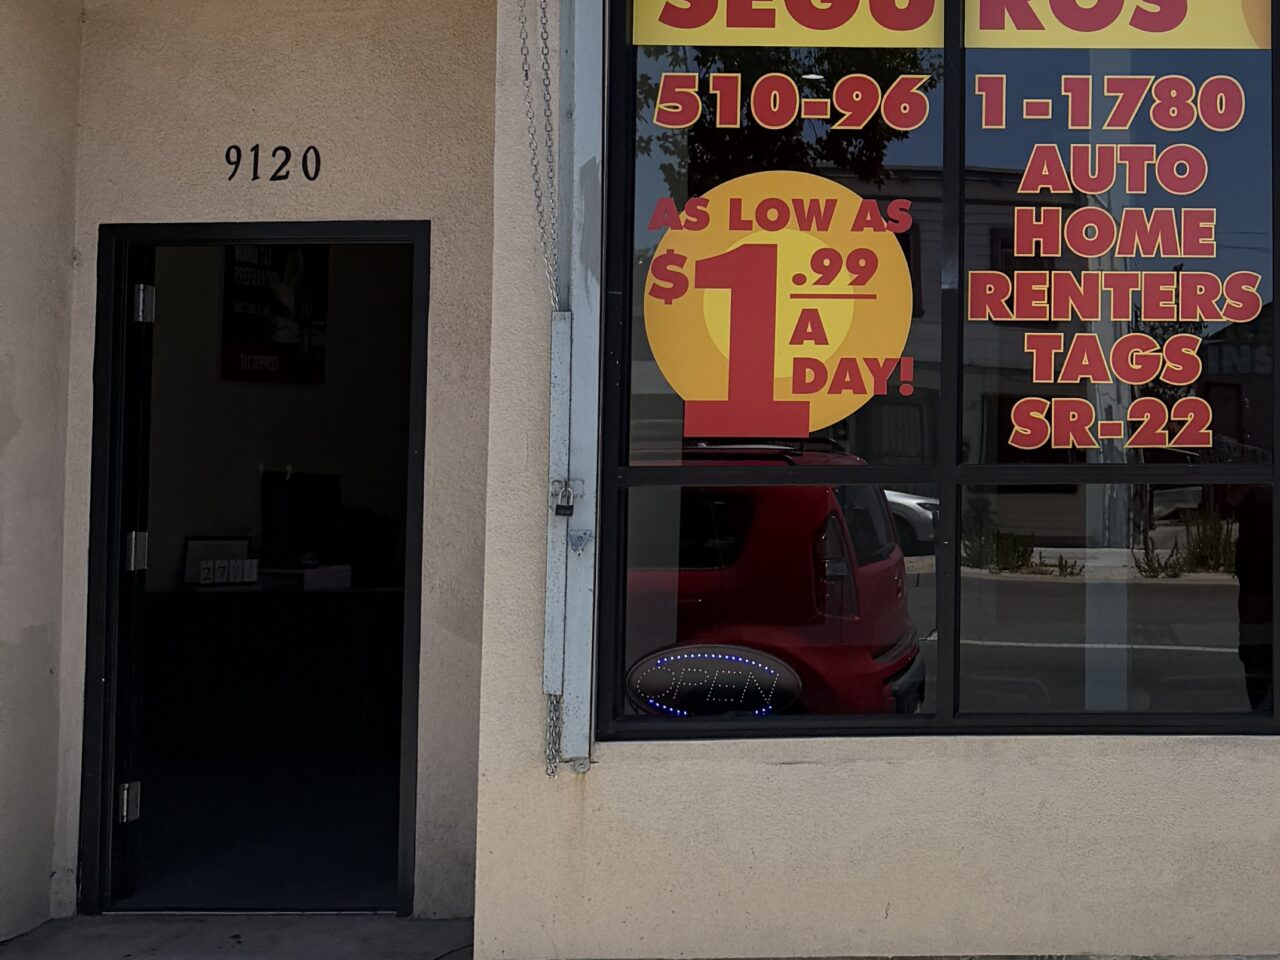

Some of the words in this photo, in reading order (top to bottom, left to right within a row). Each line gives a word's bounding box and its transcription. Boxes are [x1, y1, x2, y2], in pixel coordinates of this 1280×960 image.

[225, 144, 321, 181] 9120
[1017, 143, 1208, 195] AUTO
[648, 197, 711, 232] AS
[728, 198, 838, 232] LOW
[851, 199, 913, 233] AS
[1013, 207, 1217, 258] HOME
[968, 270, 1263, 323] RENTERS
[790, 308, 829, 346] A
[791, 357, 914, 396] DAY!
[1024, 333, 1203, 385] TAGS
[1008, 397, 1213, 449] SR-22
[636, 665, 780, 704] OPEN
